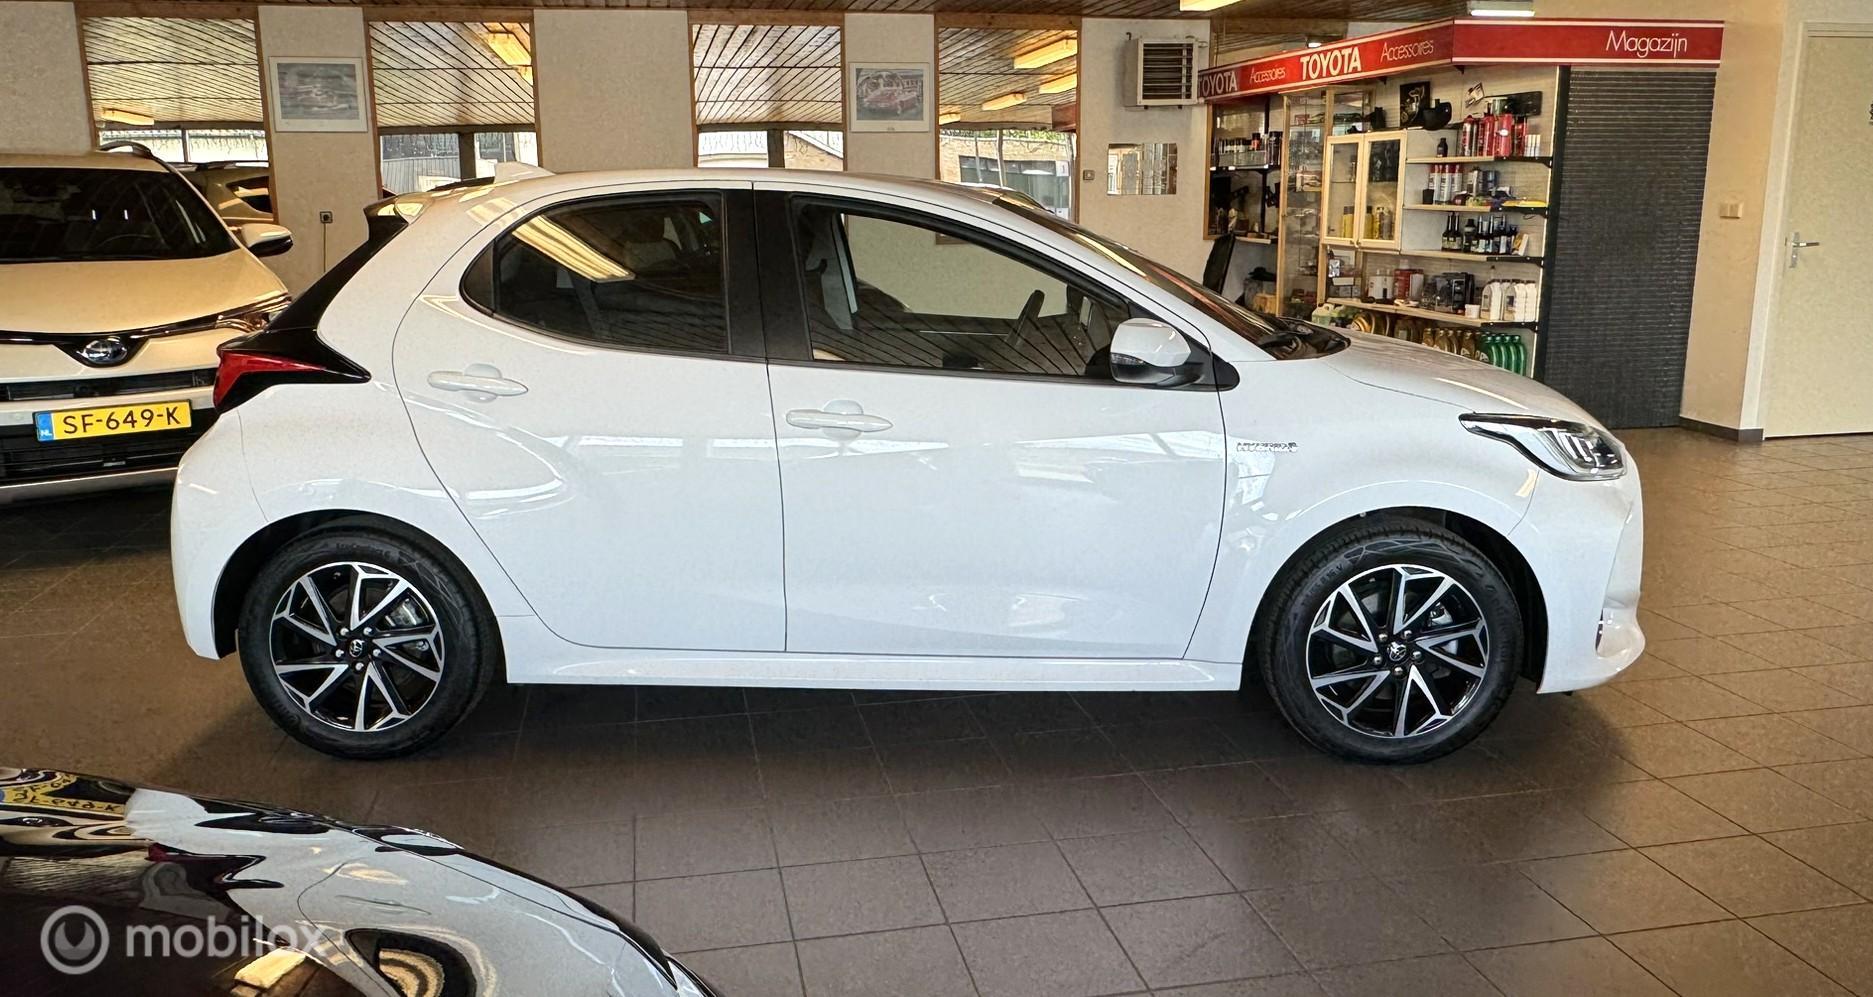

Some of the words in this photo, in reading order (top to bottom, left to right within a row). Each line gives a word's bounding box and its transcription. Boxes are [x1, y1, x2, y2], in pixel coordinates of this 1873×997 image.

[1605, 30, 1688, 58] Magazijn
[1300, 46, 1362, 80] TOYOTA
[63, 406, 181, 435] SF-649-K
